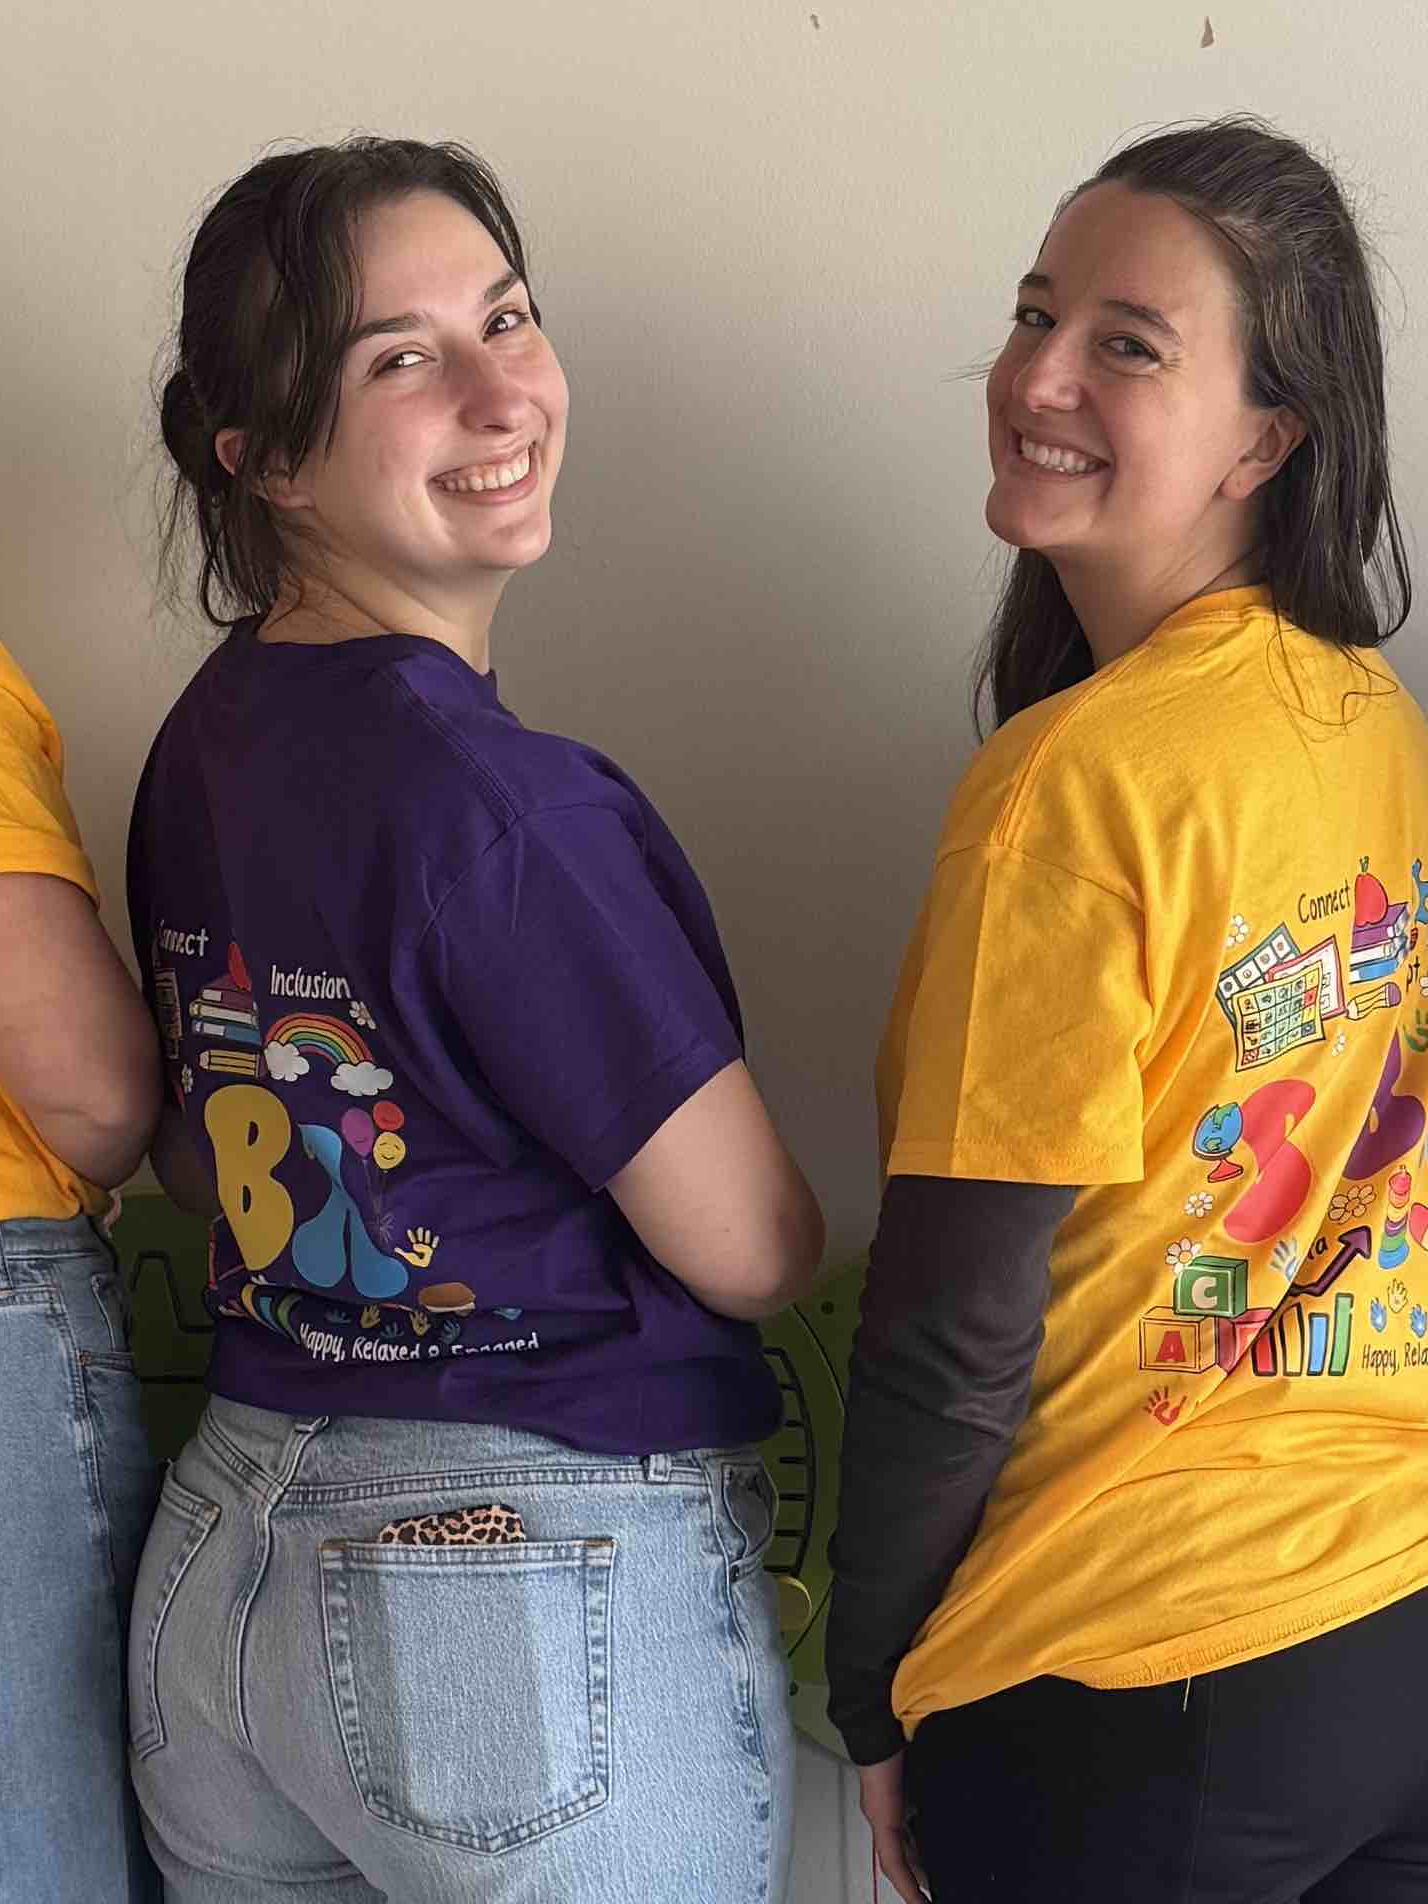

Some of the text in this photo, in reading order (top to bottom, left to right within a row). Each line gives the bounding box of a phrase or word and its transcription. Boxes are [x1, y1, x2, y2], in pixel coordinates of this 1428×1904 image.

[1298, 879, 1351, 924] Connect
[269, 963, 352, 1000] Inclusion
[352, 1335, 421, 1362] Relaxed
